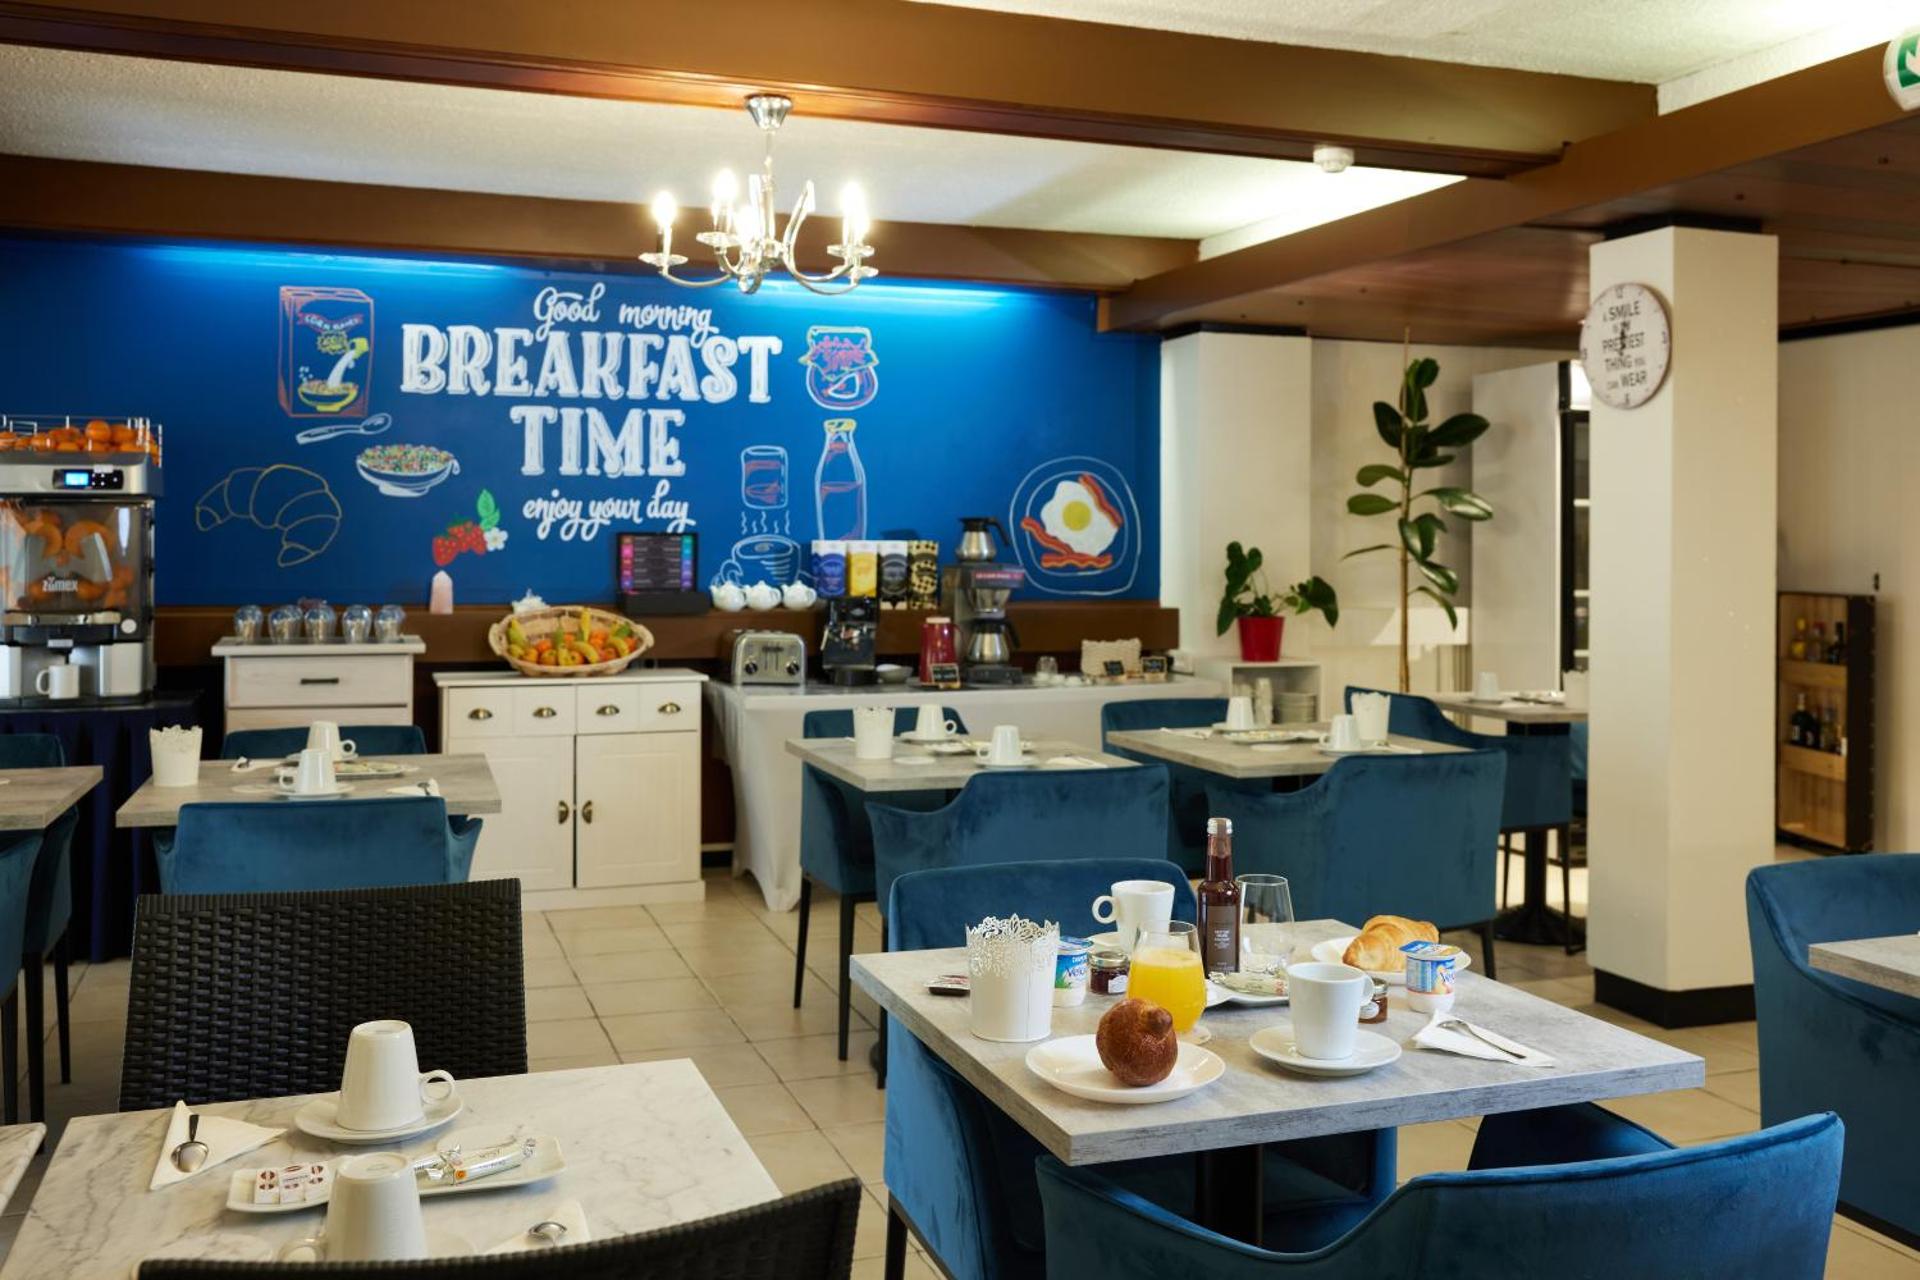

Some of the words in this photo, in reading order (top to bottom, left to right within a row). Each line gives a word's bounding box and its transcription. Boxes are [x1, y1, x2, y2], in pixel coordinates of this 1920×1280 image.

[533, 282, 606, 342] Good
[619, 303, 720, 349] morning
[1608, 301, 1640, 320] SMILE
[400, 323, 783, 404] BREAKFAST
[1620, 370, 1647, 387] WEAR
[510, 405, 686, 478] TIME
[522, 488, 583, 541] enjoy
[580, 497, 643, 541] your
[646, 479, 697, 534] day
